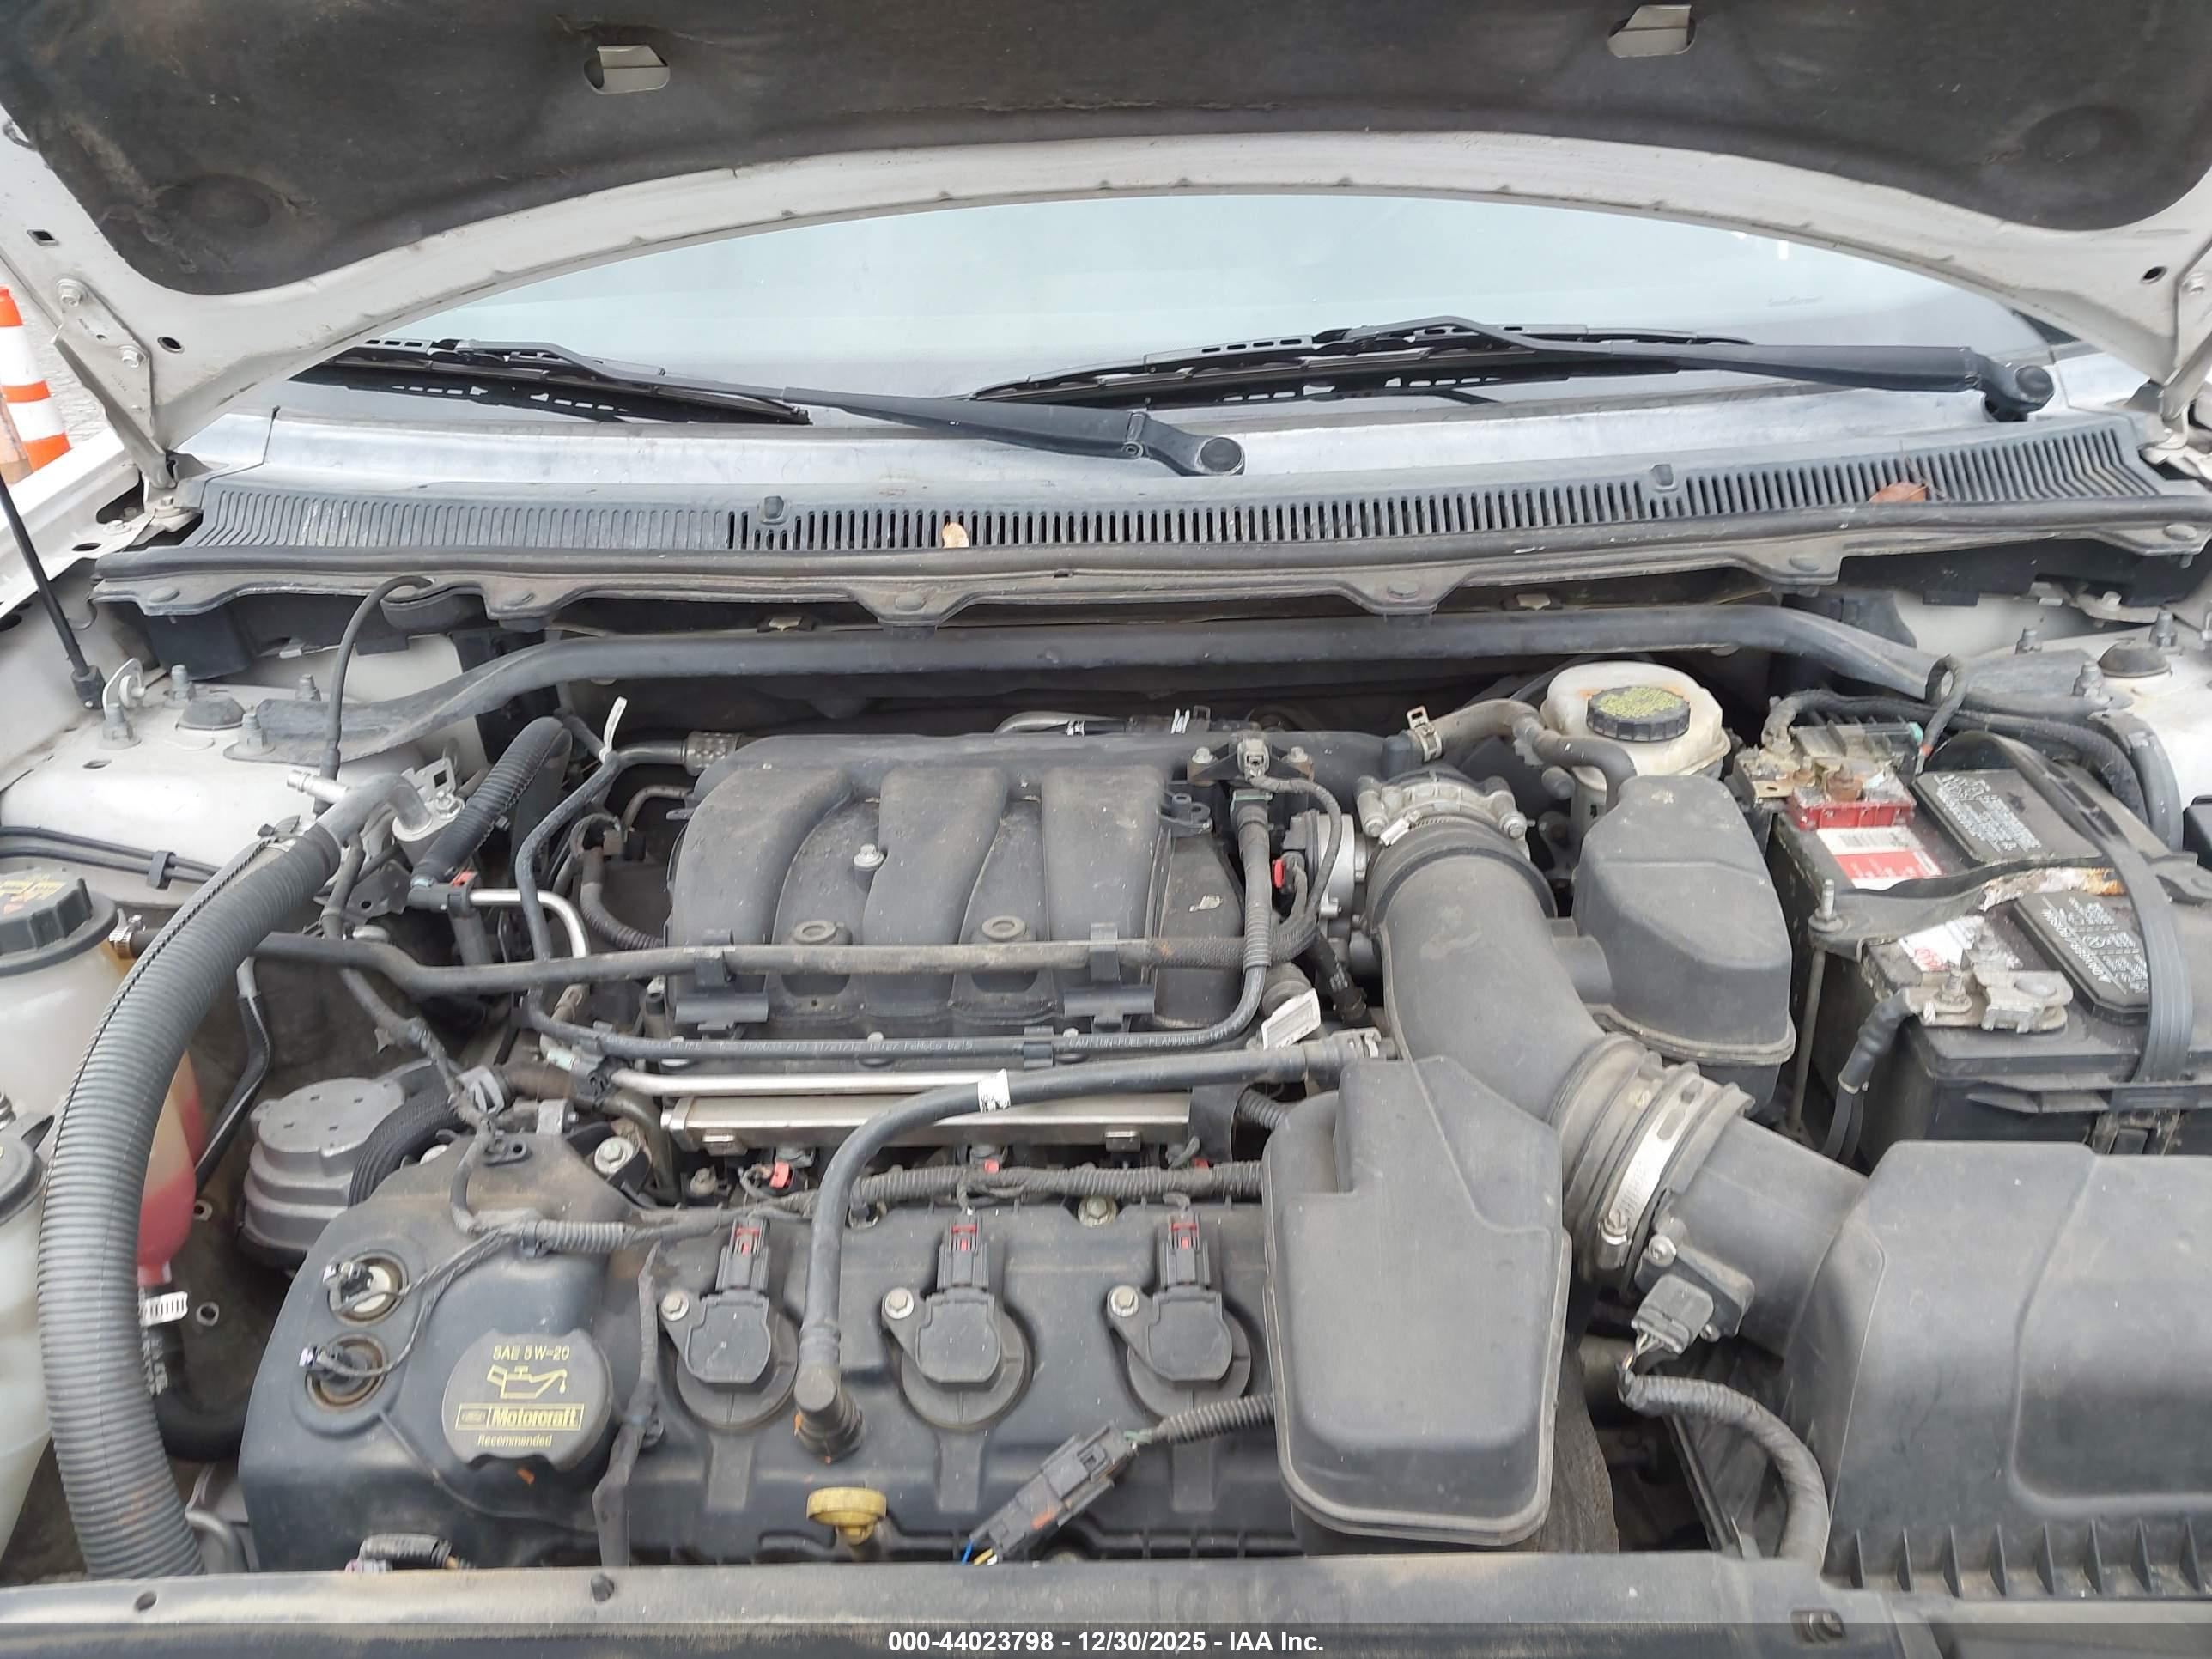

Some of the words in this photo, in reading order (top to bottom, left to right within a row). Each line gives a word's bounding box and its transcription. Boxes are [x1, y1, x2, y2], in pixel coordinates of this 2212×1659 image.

[493, 1345, 520, 1360] SAE
[524, 1345, 570, 1360] 5W-20
[492, 1407, 578, 1428] Motorcraft
[477, 1434, 553, 1448] Recommended
